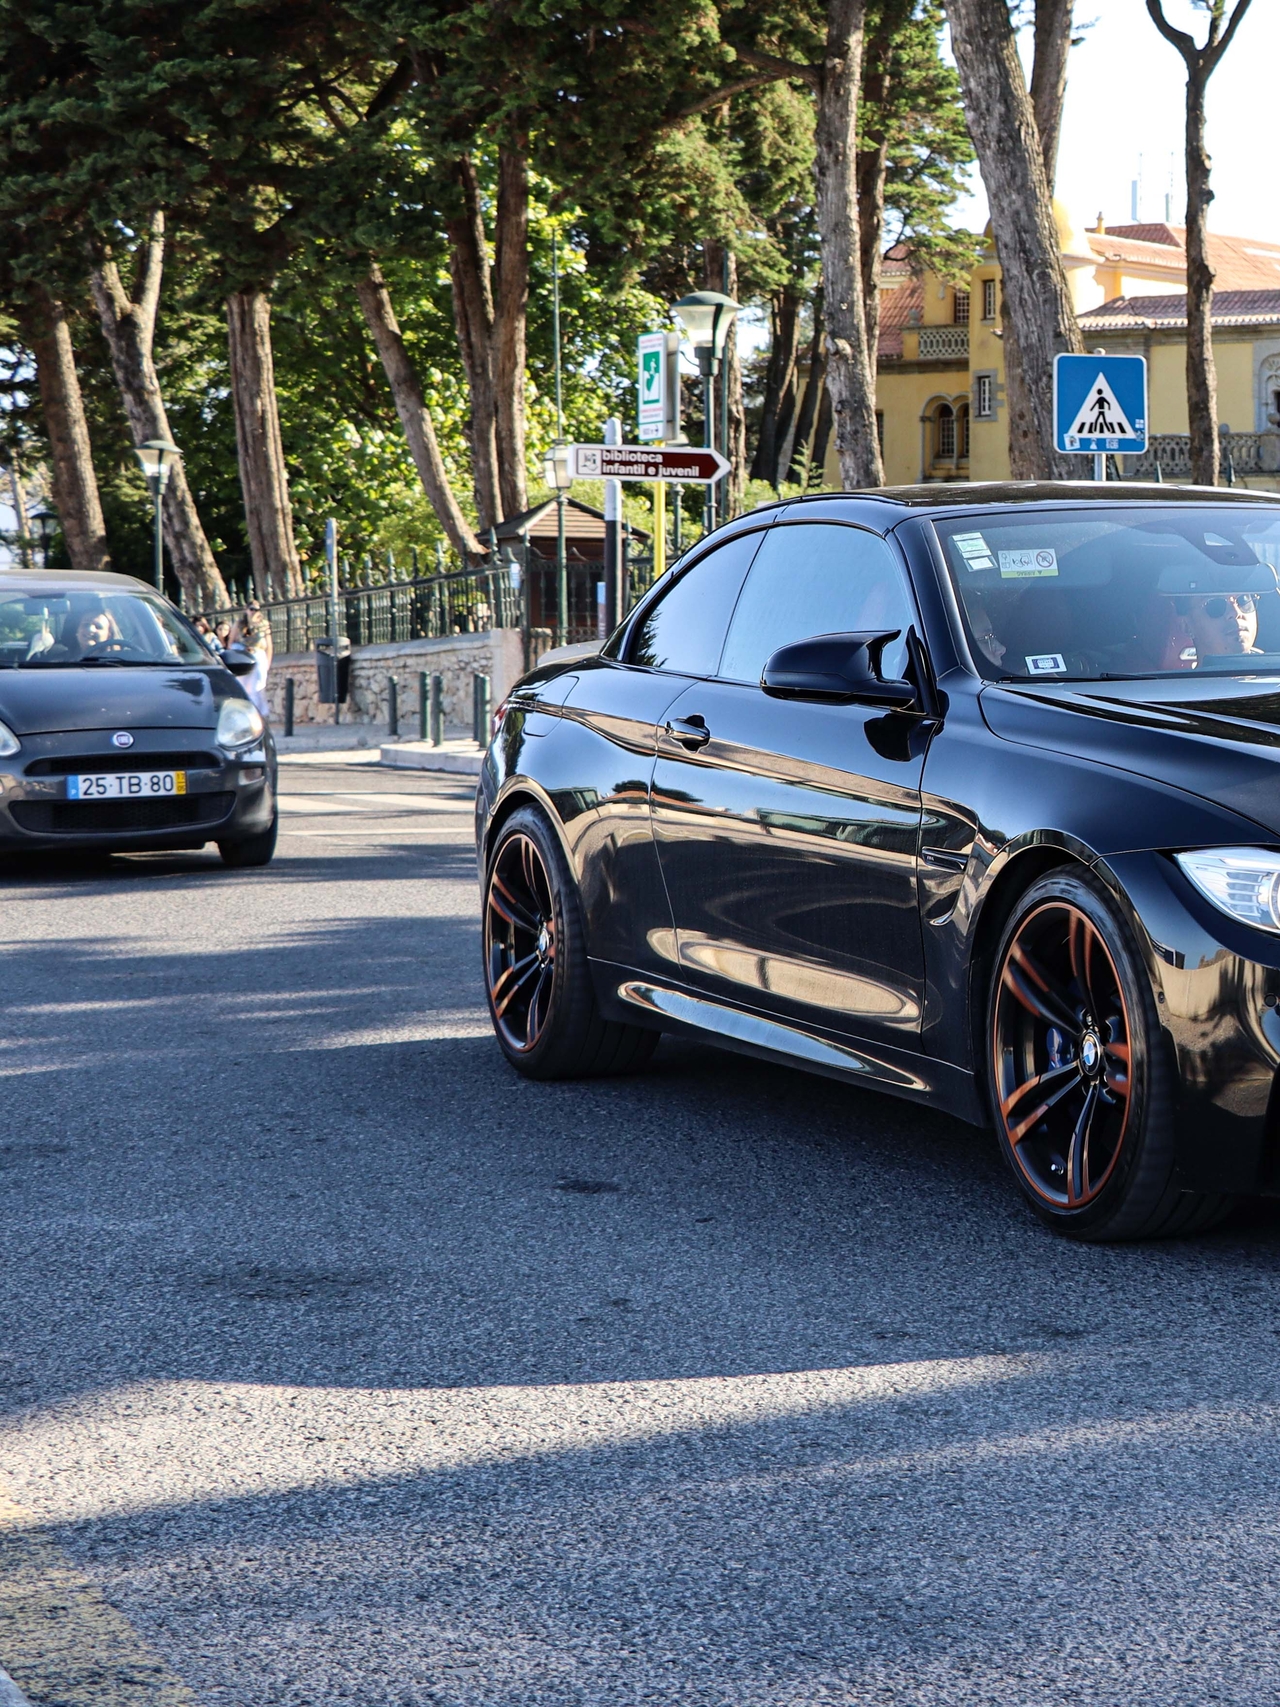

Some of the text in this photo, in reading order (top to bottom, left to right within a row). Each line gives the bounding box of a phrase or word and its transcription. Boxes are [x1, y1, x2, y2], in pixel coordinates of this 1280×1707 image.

[602, 450, 663, 463] biblioteca
[602, 463, 700, 478] infantil e juvenil
